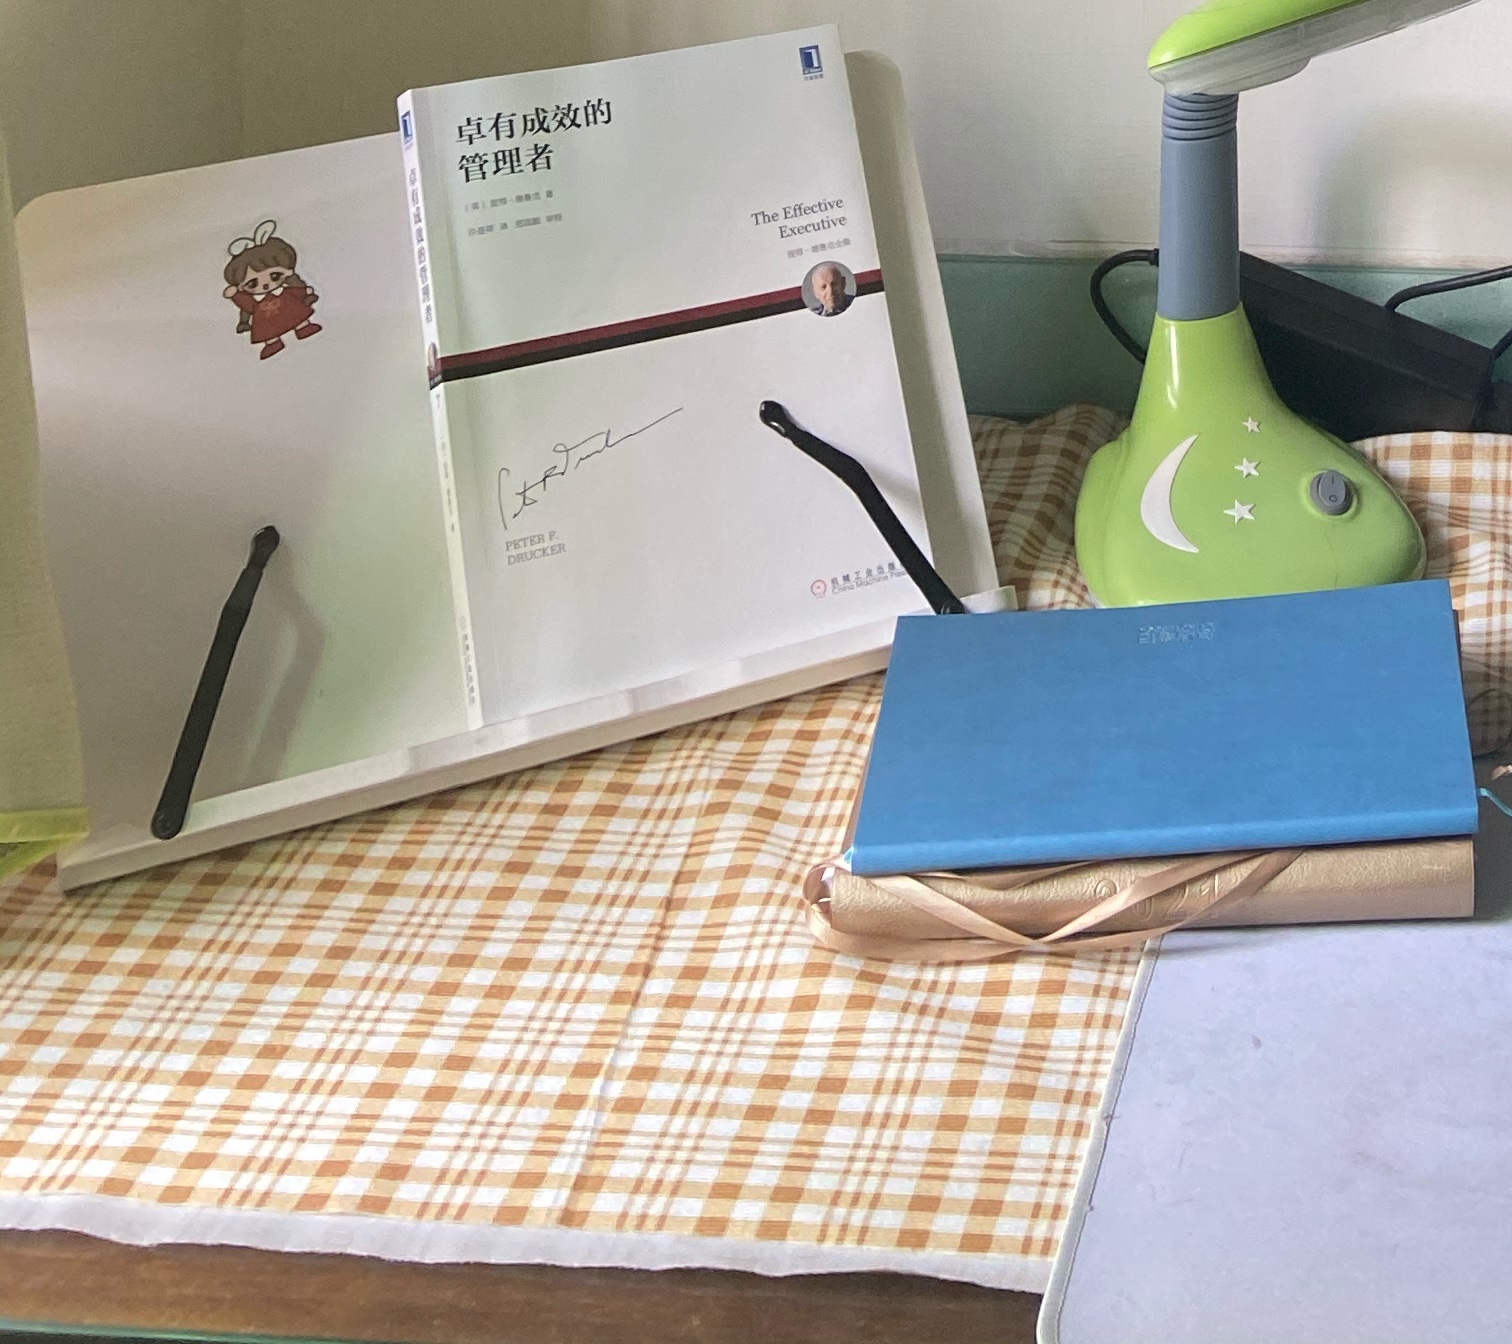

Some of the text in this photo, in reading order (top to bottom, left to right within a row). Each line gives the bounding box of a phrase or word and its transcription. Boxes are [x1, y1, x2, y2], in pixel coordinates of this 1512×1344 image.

[455, 97, 614, 147] 卓有成效的
[456, 142, 555, 185] 管理者
[750, 195, 845, 229] The Effective
[778, 213, 848, 240] Executive
[504, 532, 545, 553] PETER
[505, 542, 567, 567] DRUCKER
